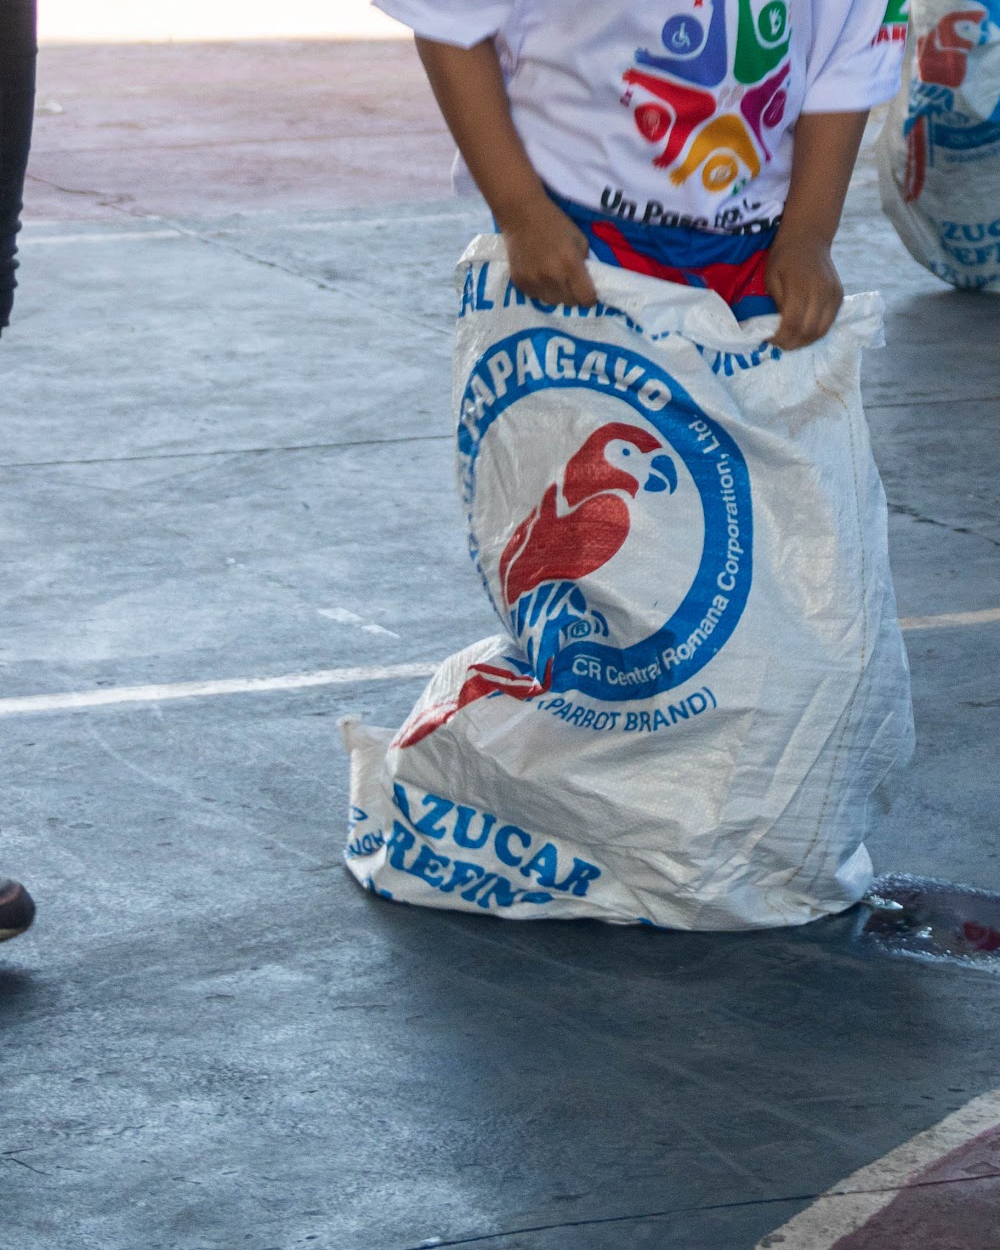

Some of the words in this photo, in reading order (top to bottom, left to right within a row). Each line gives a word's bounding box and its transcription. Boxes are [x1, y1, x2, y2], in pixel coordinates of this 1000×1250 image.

[600, 183, 638, 221] Un
[462, 336, 672, 442] PAPAGAYO
[571, 653, 602, 681] CR
[662, 593, 730, 671] Romana
[623, 686, 718, 733] BRAND)
